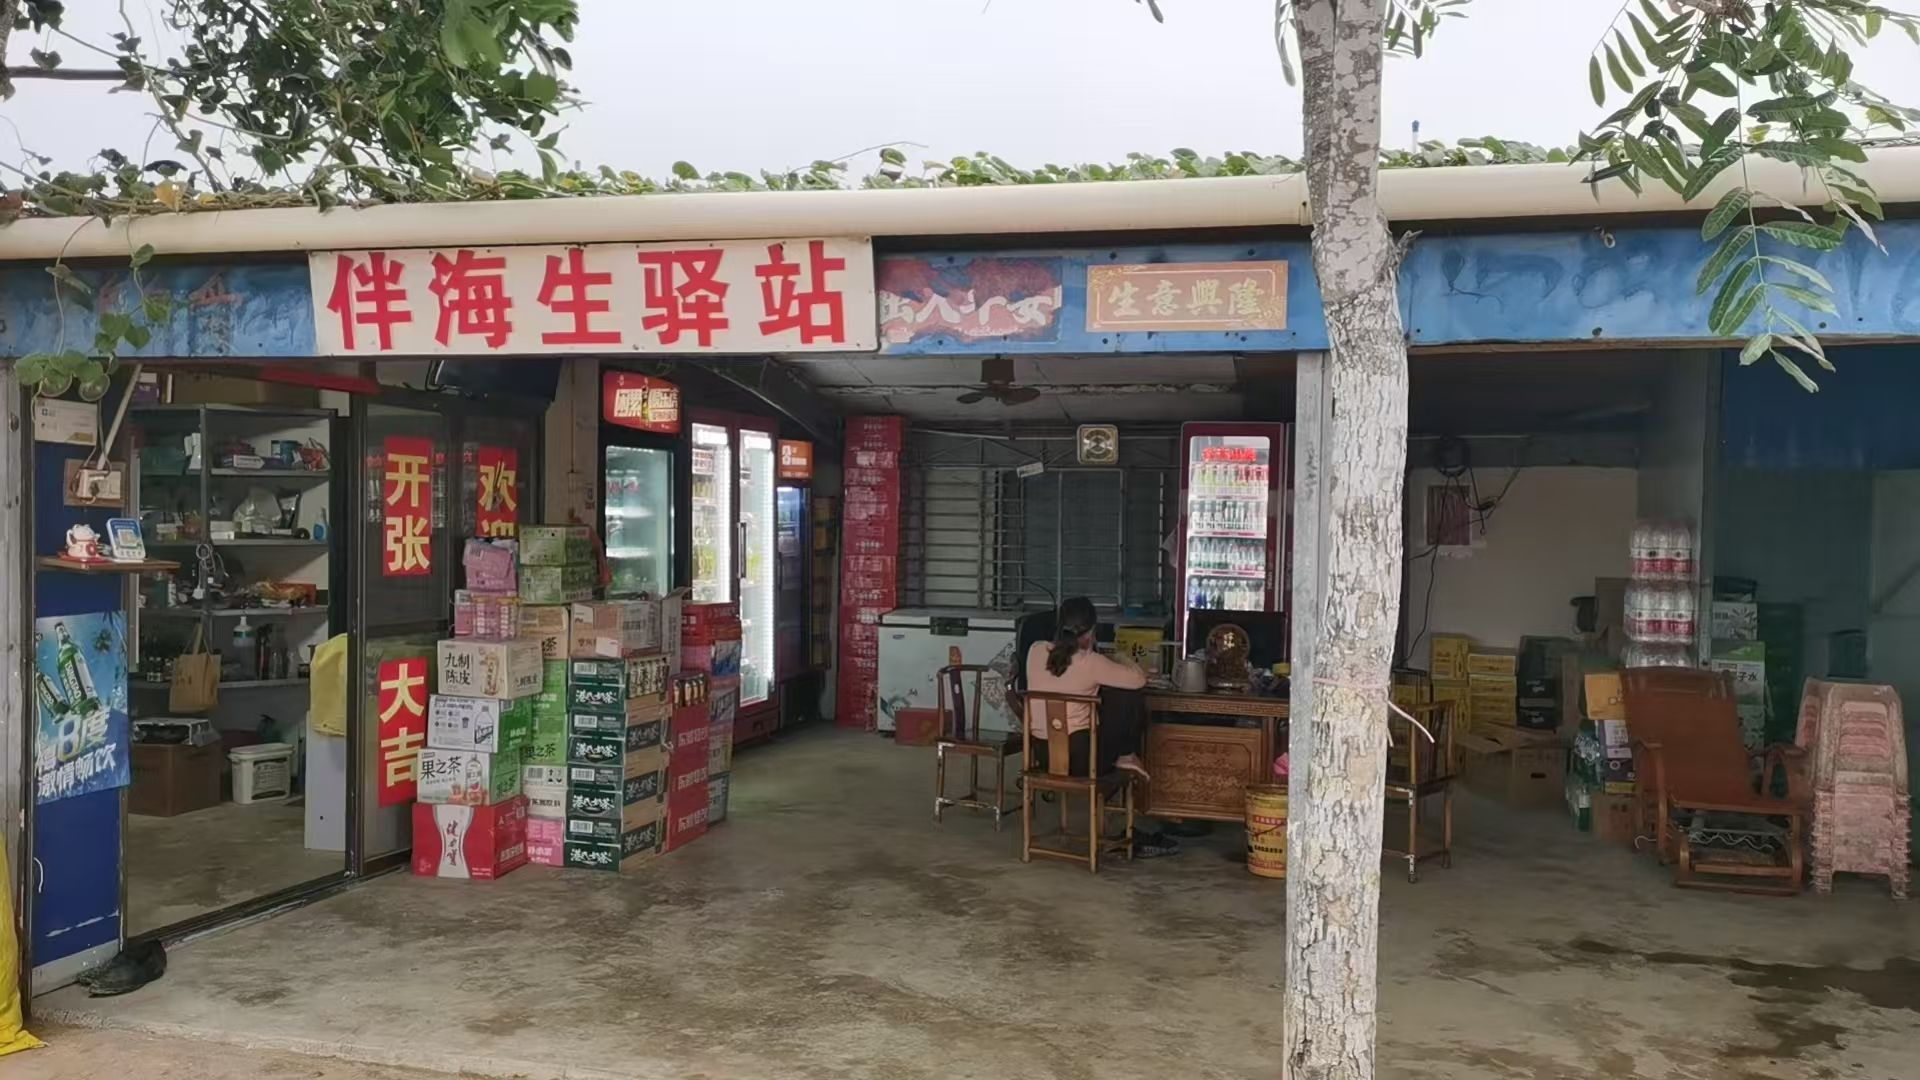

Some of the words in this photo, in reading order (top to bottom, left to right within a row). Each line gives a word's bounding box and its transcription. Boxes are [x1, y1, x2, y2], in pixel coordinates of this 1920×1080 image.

[327, 239, 846, 351] 伴海生驿站
[385, 453, 430, 572] 开张
[37, 743, 117, 798] 激情畅饮
[380, 663, 424, 787] 大吉
[420, 756, 462, 782] 果之茶
